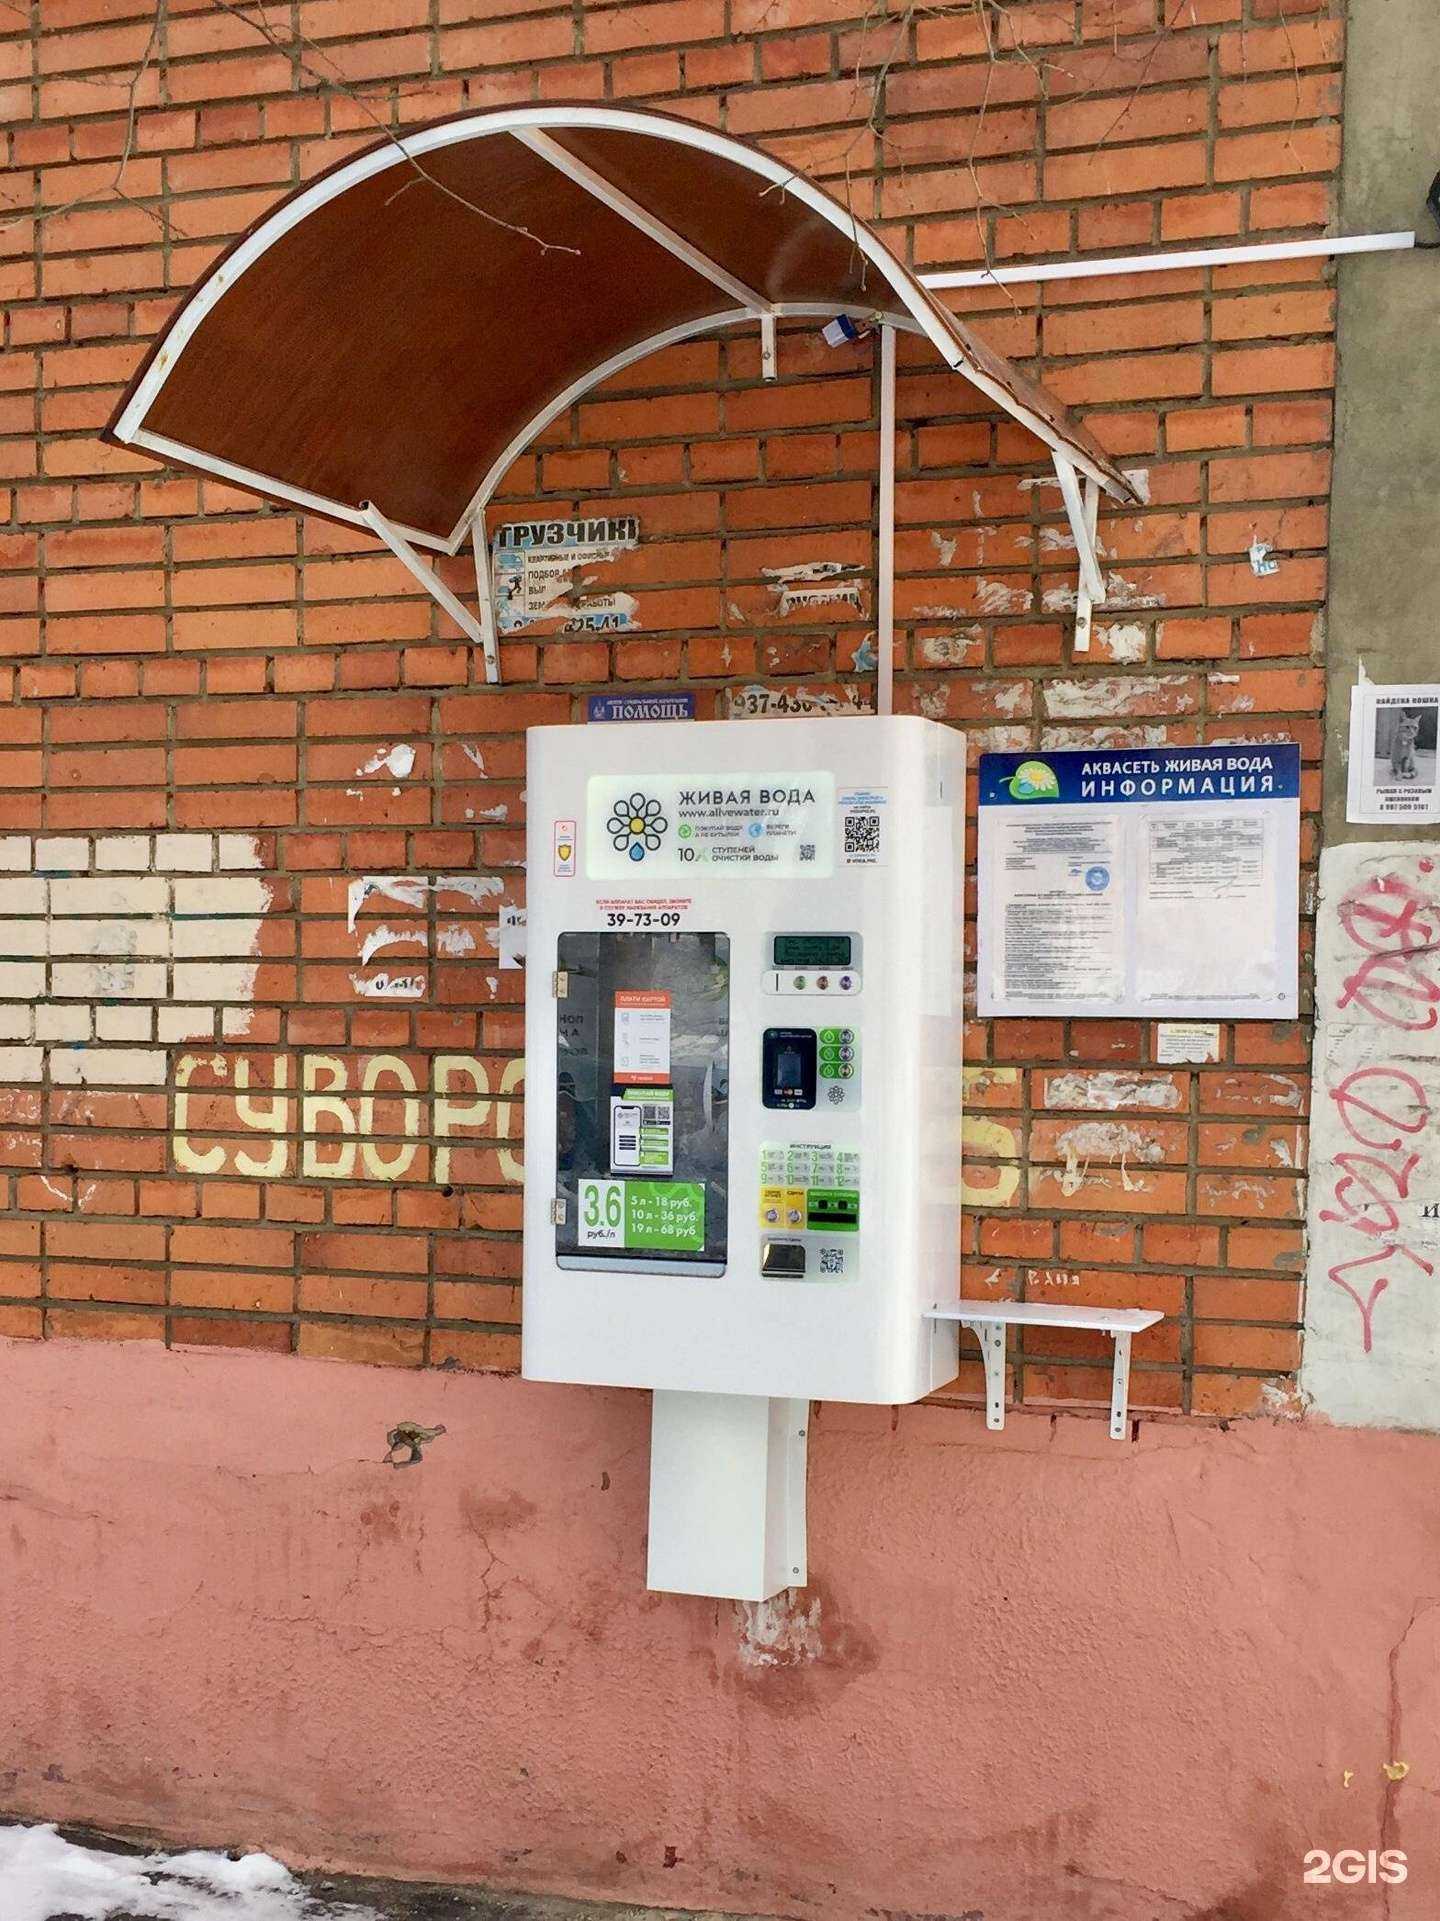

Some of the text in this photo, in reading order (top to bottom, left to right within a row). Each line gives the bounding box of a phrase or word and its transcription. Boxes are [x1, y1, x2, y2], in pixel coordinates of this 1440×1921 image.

[610, 703, 689, 720] ПОМОЩЬ
[1081, 757, 1274, 775] АКВАСЕТЬ ЖИВАЯ ВОДА
[1081, 775, 1274, 798] ИНФОРМАЦИЯ
[678, 789, 815, 805] ЖИВАЯ ВОДА
[678, 848, 695, 862] 10
[712, 845, 756, 854] СТУПЕНЕЙ
[712, 854, 779, 862] ОЧИСТКИ ВОДЫ
[607, 912, 680, 927] 39-73-09
[584, 1185, 621, 1228] 3.6
[656, 1197, 667, 1206] 18
[670, 1197, 692, 1209] руб.
[631, 1209, 644, 1220] 10
[661, 1210, 674, 1220] 36
[631, 1223, 644, 1233] 19
[661, 1224, 674, 1235] 68
